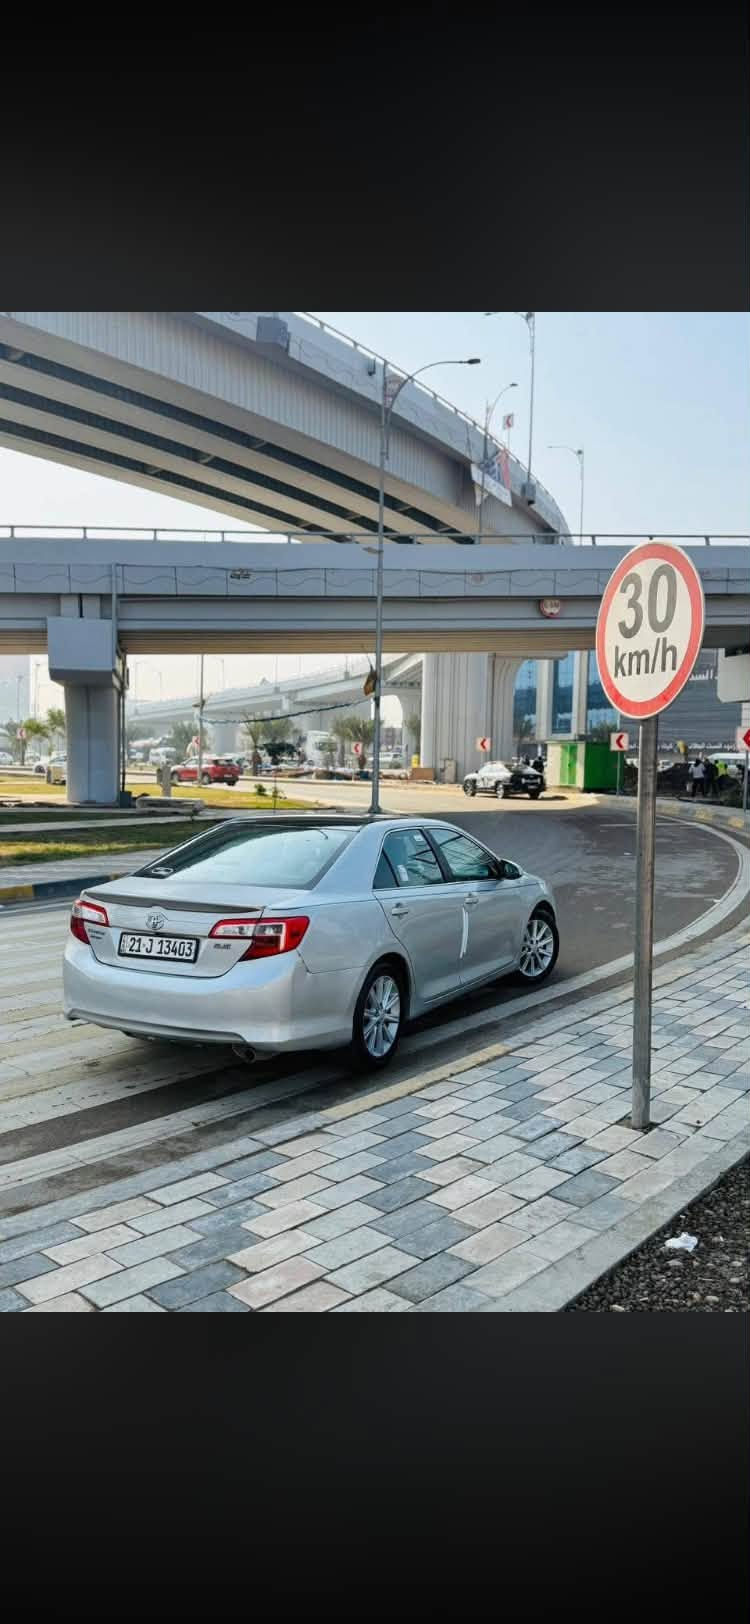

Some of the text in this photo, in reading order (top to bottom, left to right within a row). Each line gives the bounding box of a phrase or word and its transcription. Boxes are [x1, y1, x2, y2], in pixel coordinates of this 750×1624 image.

[618, 564, 677, 639] 30
[614, 637, 677, 679] km/h
[156, 939, 194, 957] 13403
